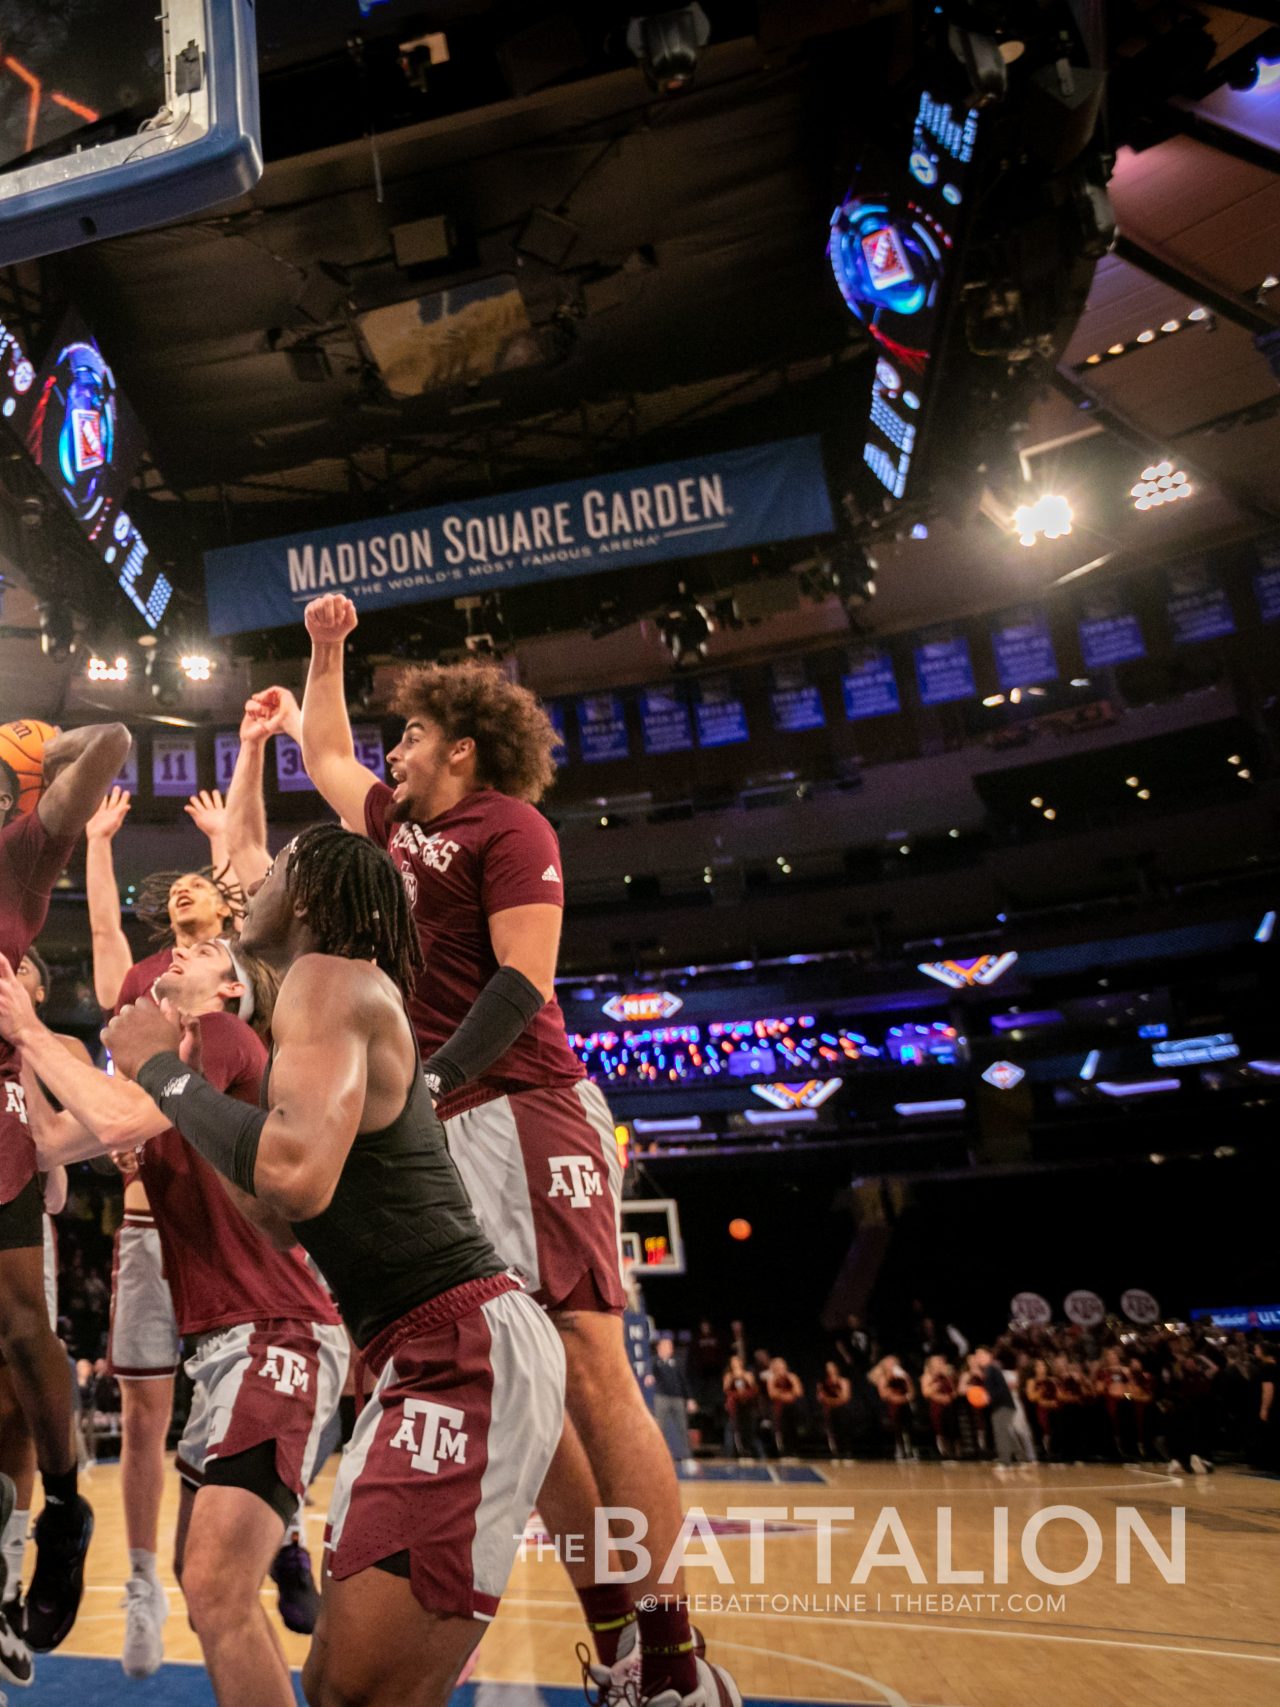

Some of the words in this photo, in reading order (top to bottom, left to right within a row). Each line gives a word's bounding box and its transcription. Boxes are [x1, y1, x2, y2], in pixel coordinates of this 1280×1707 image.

[287, 528, 433, 592] MADISON
[442, 502, 575, 564] SQUARE
[352, 583, 383, 597] THE
[388, 569, 463, 590] WORLD'S
[469, 559, 515, 577] MOST
[522, 545, 593, 567] FAMOUS
[547, 1155, 604, 1208] ATM
[258, 1346, 310, 1395] ATM
[390, 1397, 468, 1475] ATM
